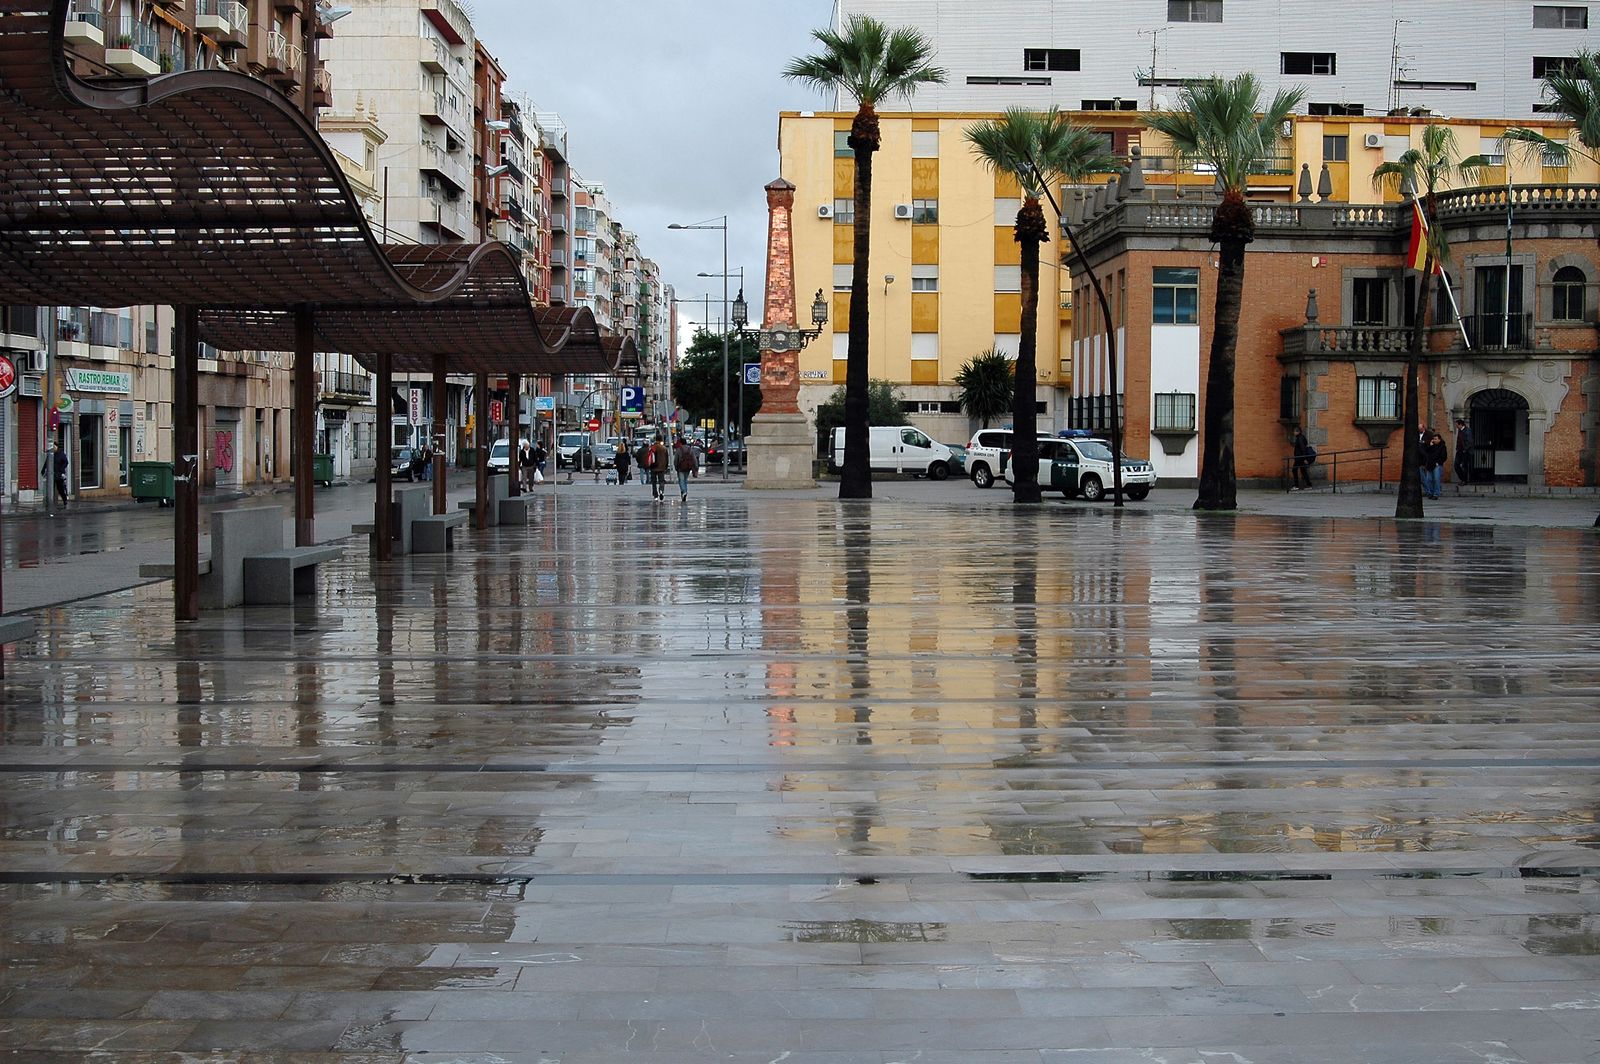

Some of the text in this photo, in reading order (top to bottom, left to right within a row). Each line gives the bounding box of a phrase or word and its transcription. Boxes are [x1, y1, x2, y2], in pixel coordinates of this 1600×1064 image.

[79, 372, 120, 385] RASTRO REMAR
[622, 388, 635, 407] P
